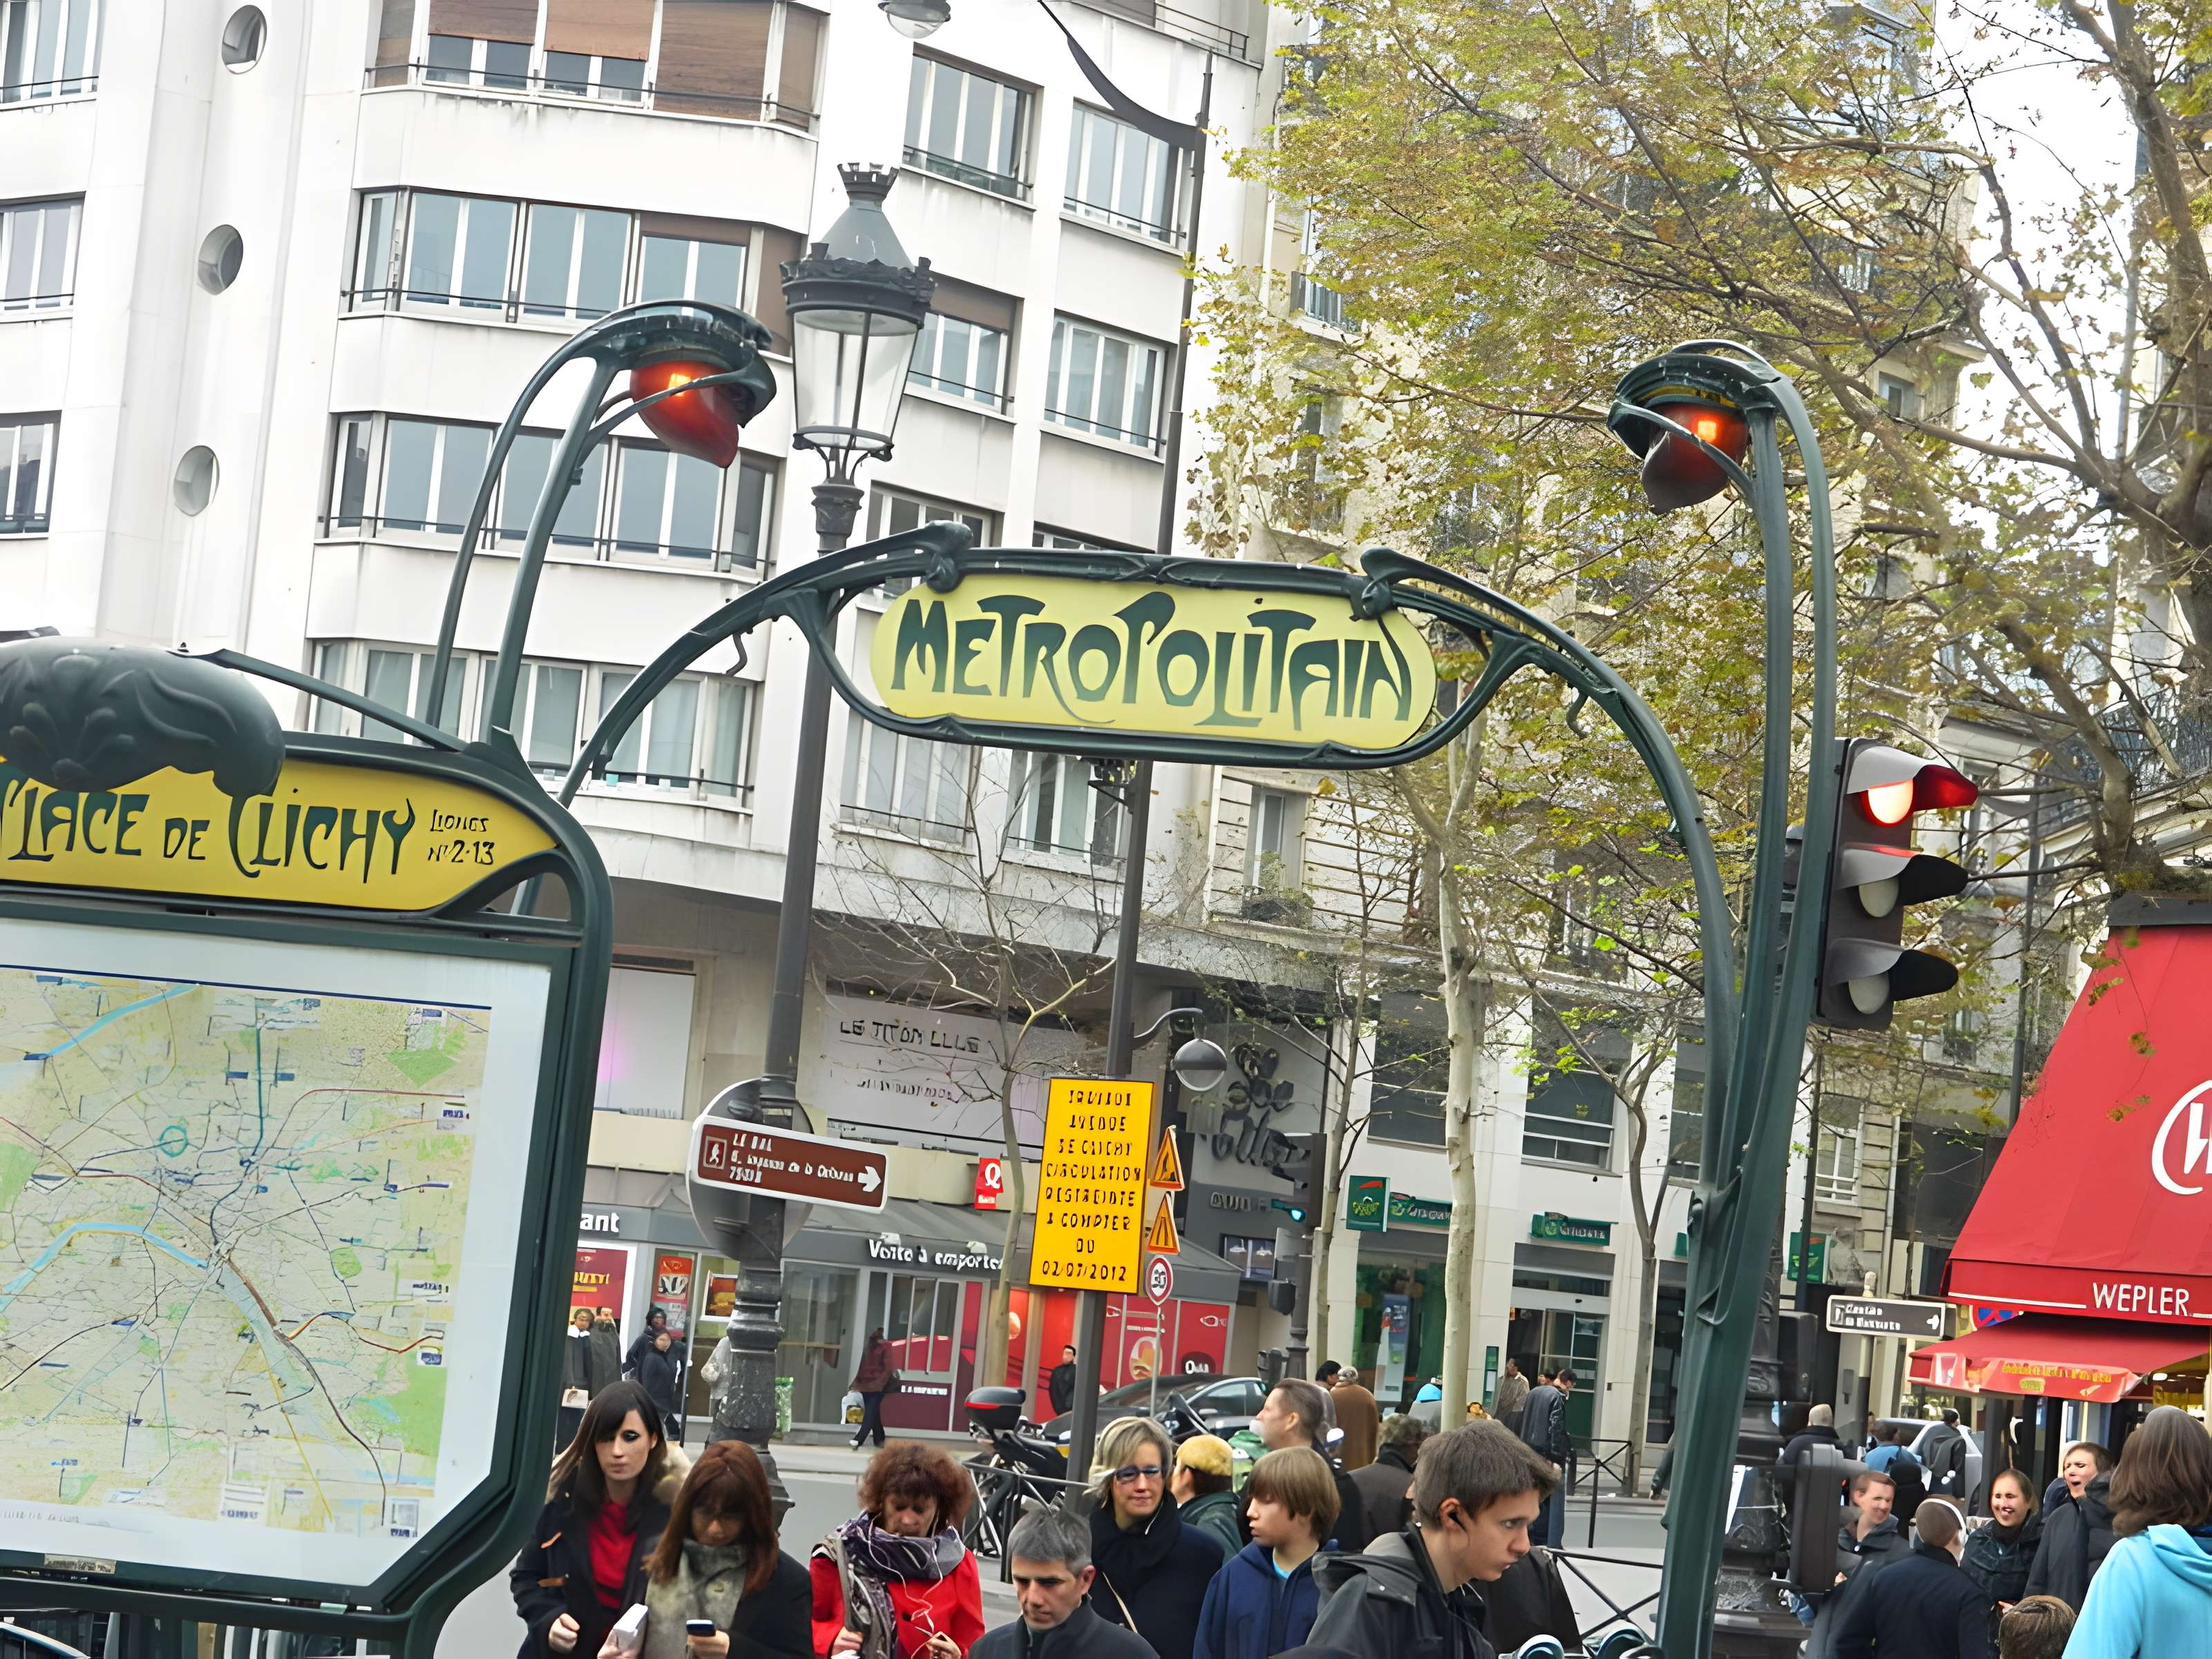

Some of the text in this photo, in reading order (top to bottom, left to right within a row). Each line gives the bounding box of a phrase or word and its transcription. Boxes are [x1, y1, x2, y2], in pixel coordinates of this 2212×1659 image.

[891, 591, 1412, 731] METROPOLITAIN
[163, 817, 210, 860] DE
[228, 787, 415, 883] CLICHY
[2092, 1282, 2190, 1317] WEPLER
